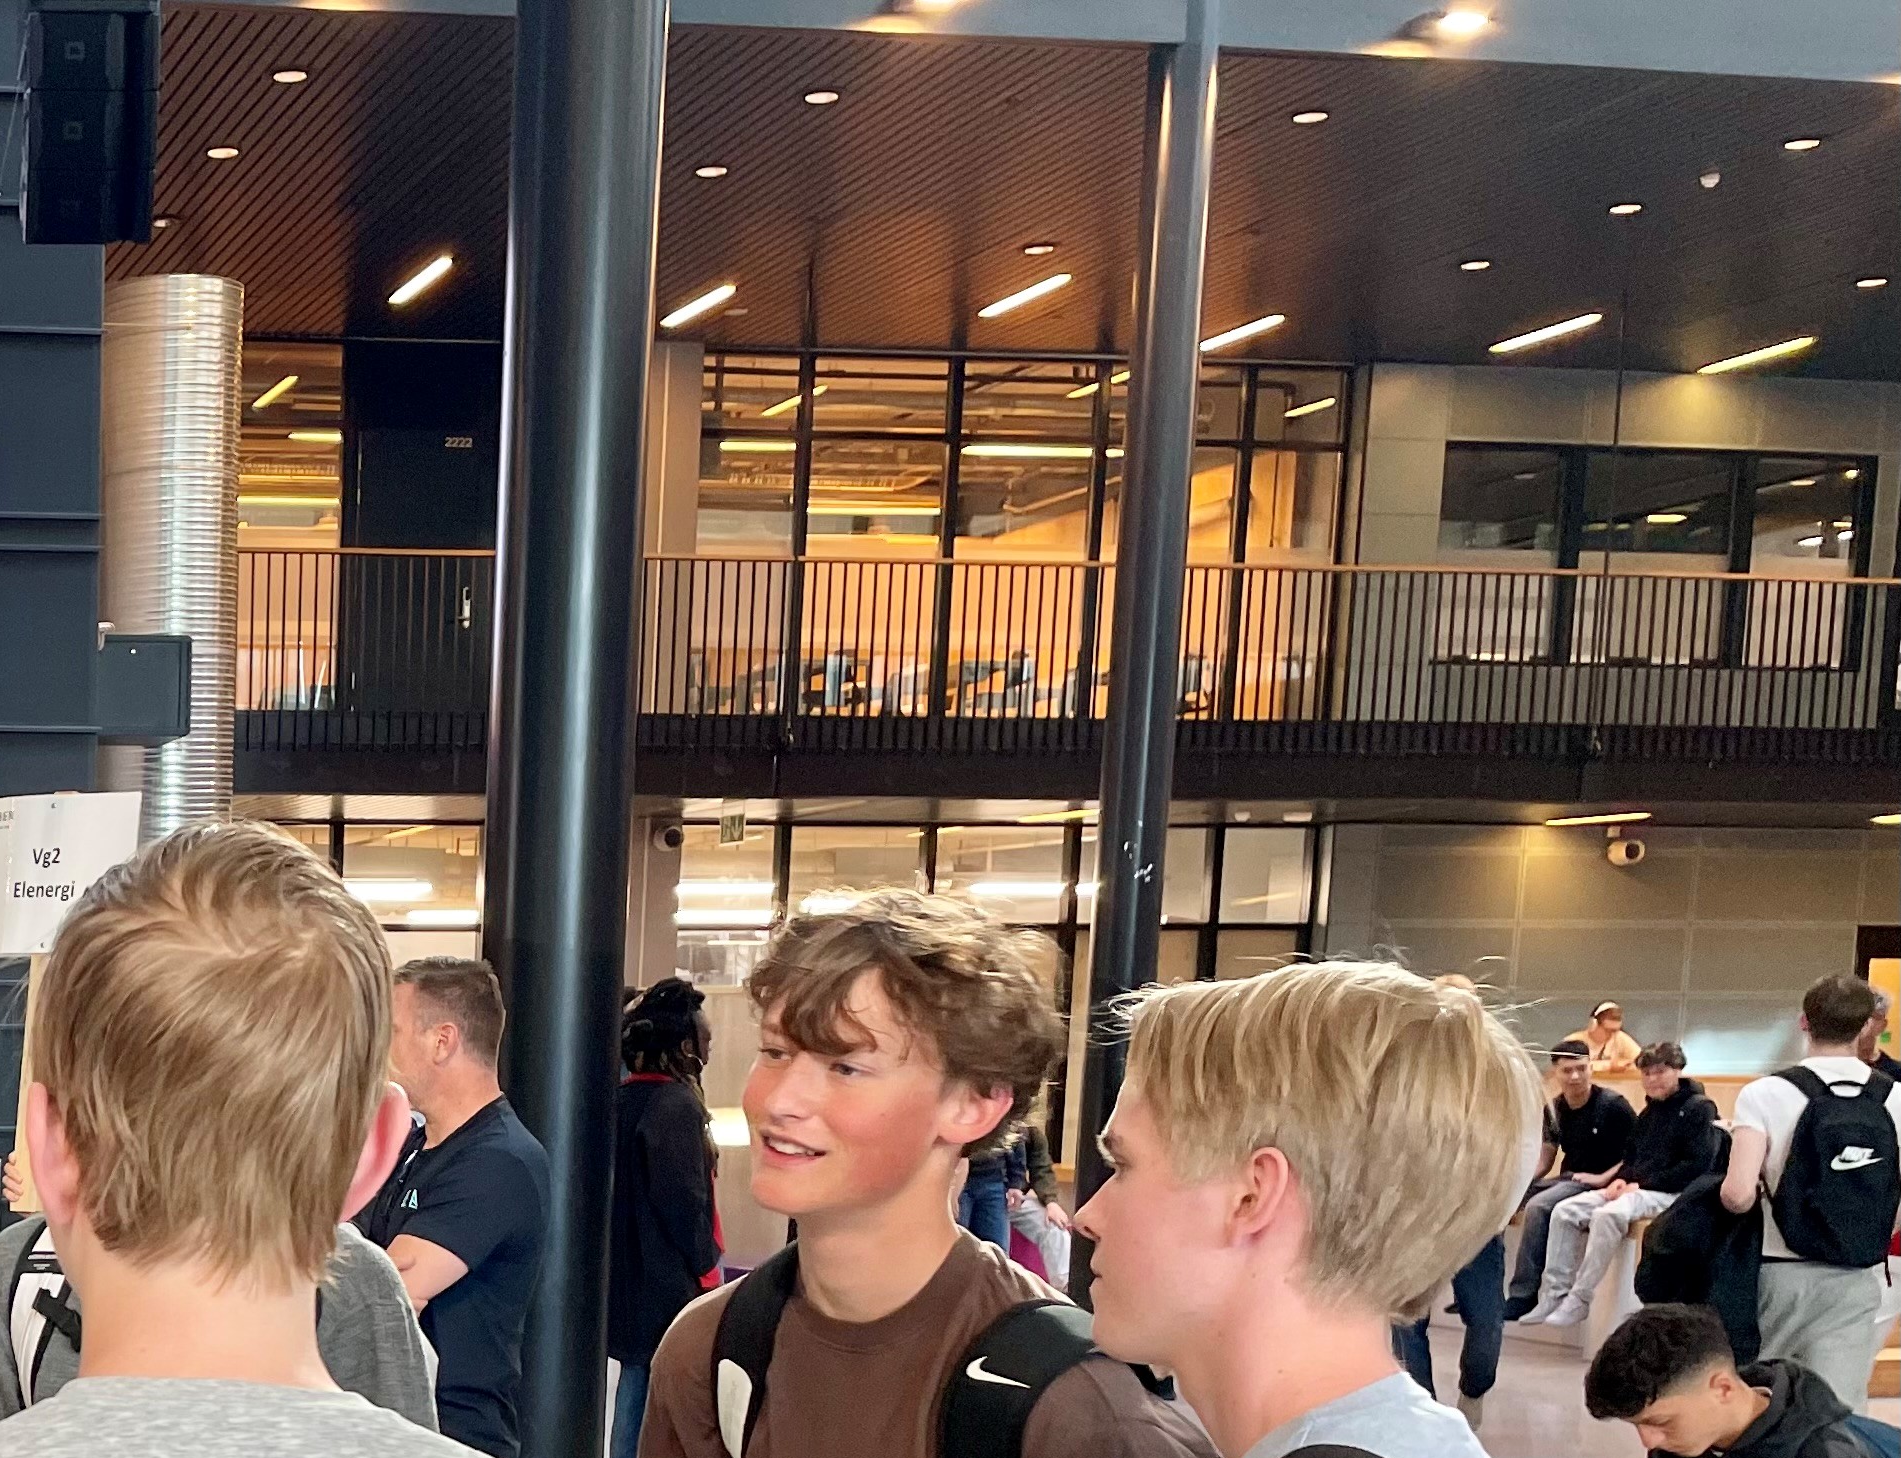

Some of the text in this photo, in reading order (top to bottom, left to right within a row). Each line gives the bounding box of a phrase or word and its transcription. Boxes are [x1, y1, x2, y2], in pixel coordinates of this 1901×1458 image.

[445, 437, 472, 447] 2222
[33, 848, 61, 868] Vg2
[13, 881, 76, 901] Elenergi
